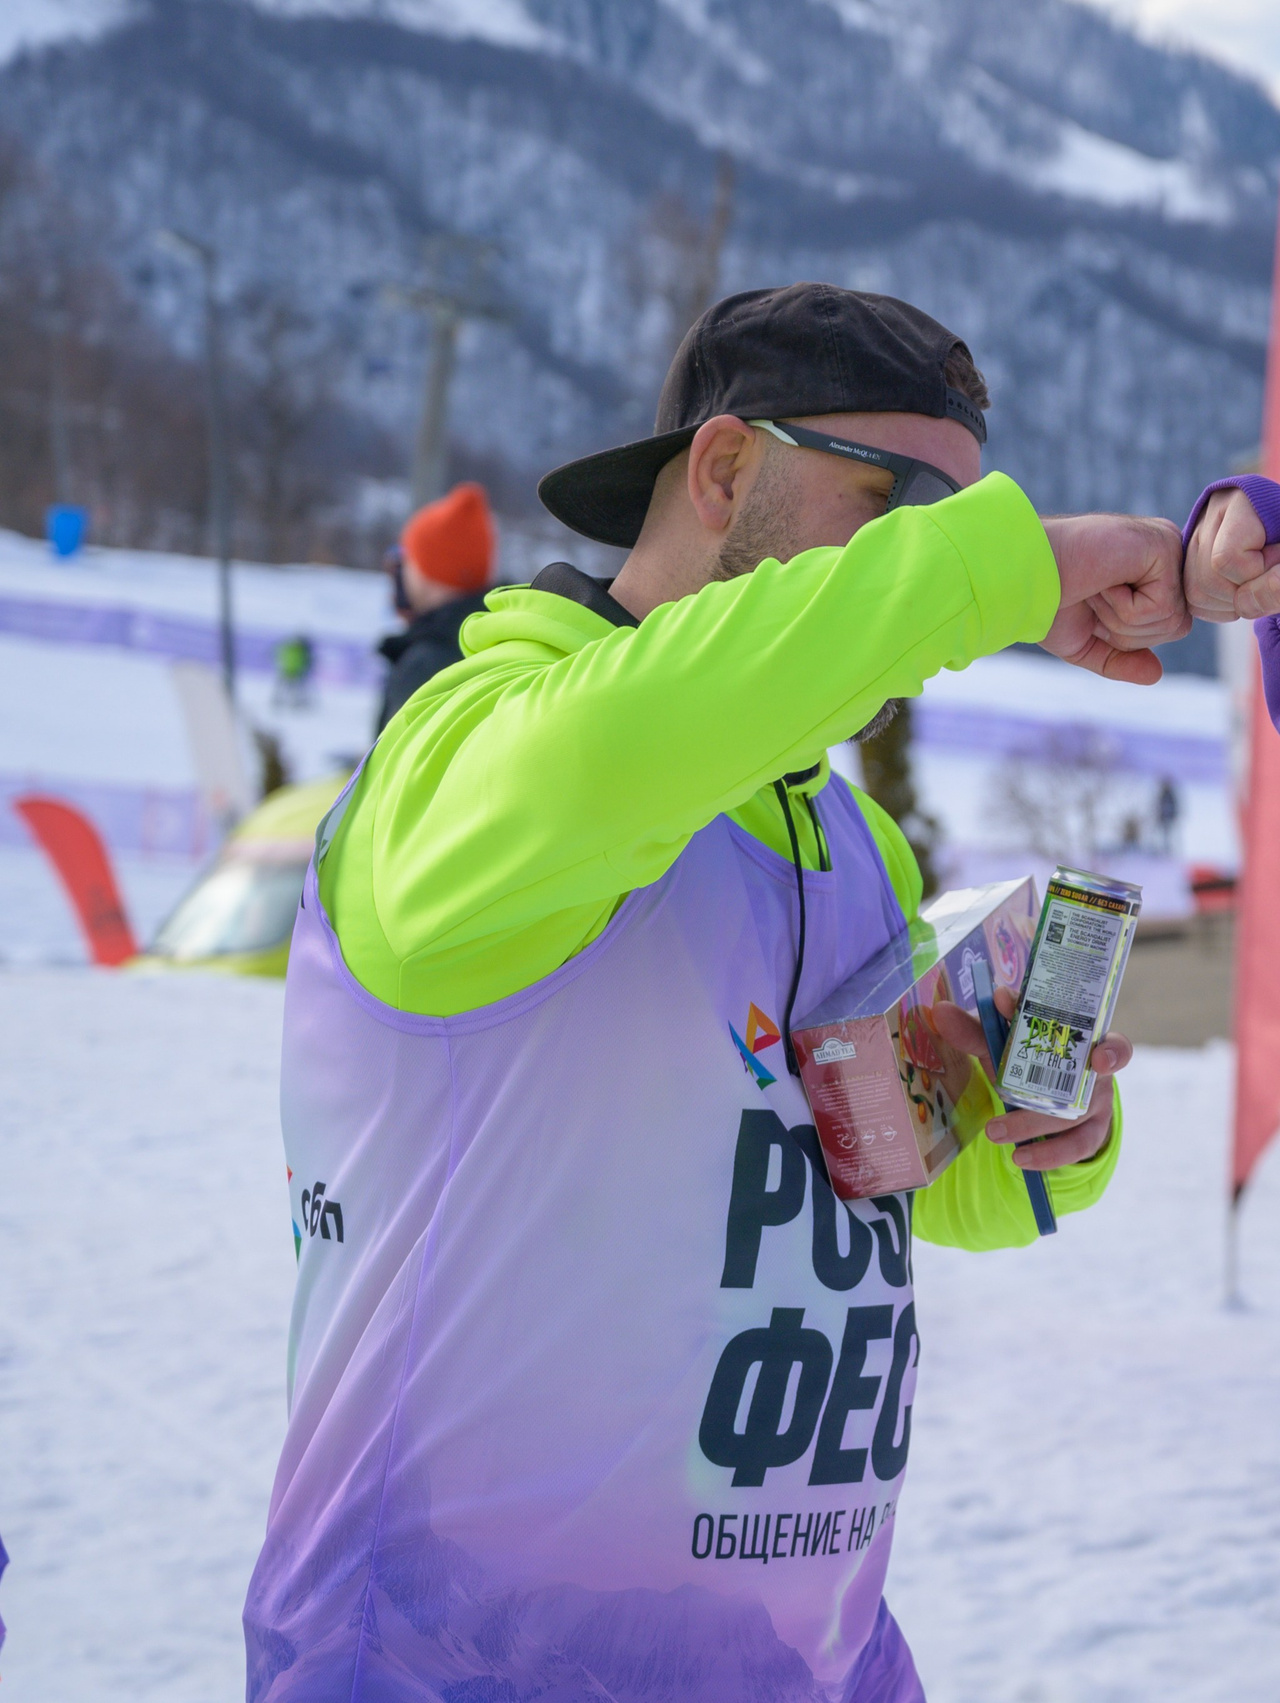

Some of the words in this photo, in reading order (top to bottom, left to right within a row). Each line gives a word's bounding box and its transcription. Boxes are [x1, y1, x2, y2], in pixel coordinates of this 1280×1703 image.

[828, 441, 853, 453] Alexander
[1060, 888, 1071, 897] ZERO
[1072, 891, 1088, 902] SUGAR
[1081, 914, 1108, 925] SCANDALIST
[1070, 933, 1090, 942] ENERGY
[1092, 938, 1107, 947] DRINK
[1080, 930, 1110, 942] SCANDALIST
[1029, 1017, 1079, 1048] DRINK
[815, 1048, 840, 1059] AHMAD
[840, 1045, 854, 1054] TEA
[1009, 1065, 1023, 1076] 330
[691, 1510, 846, 1564] ОБЩЕНИЕ
[847, 1506, 877, 1552] НА
